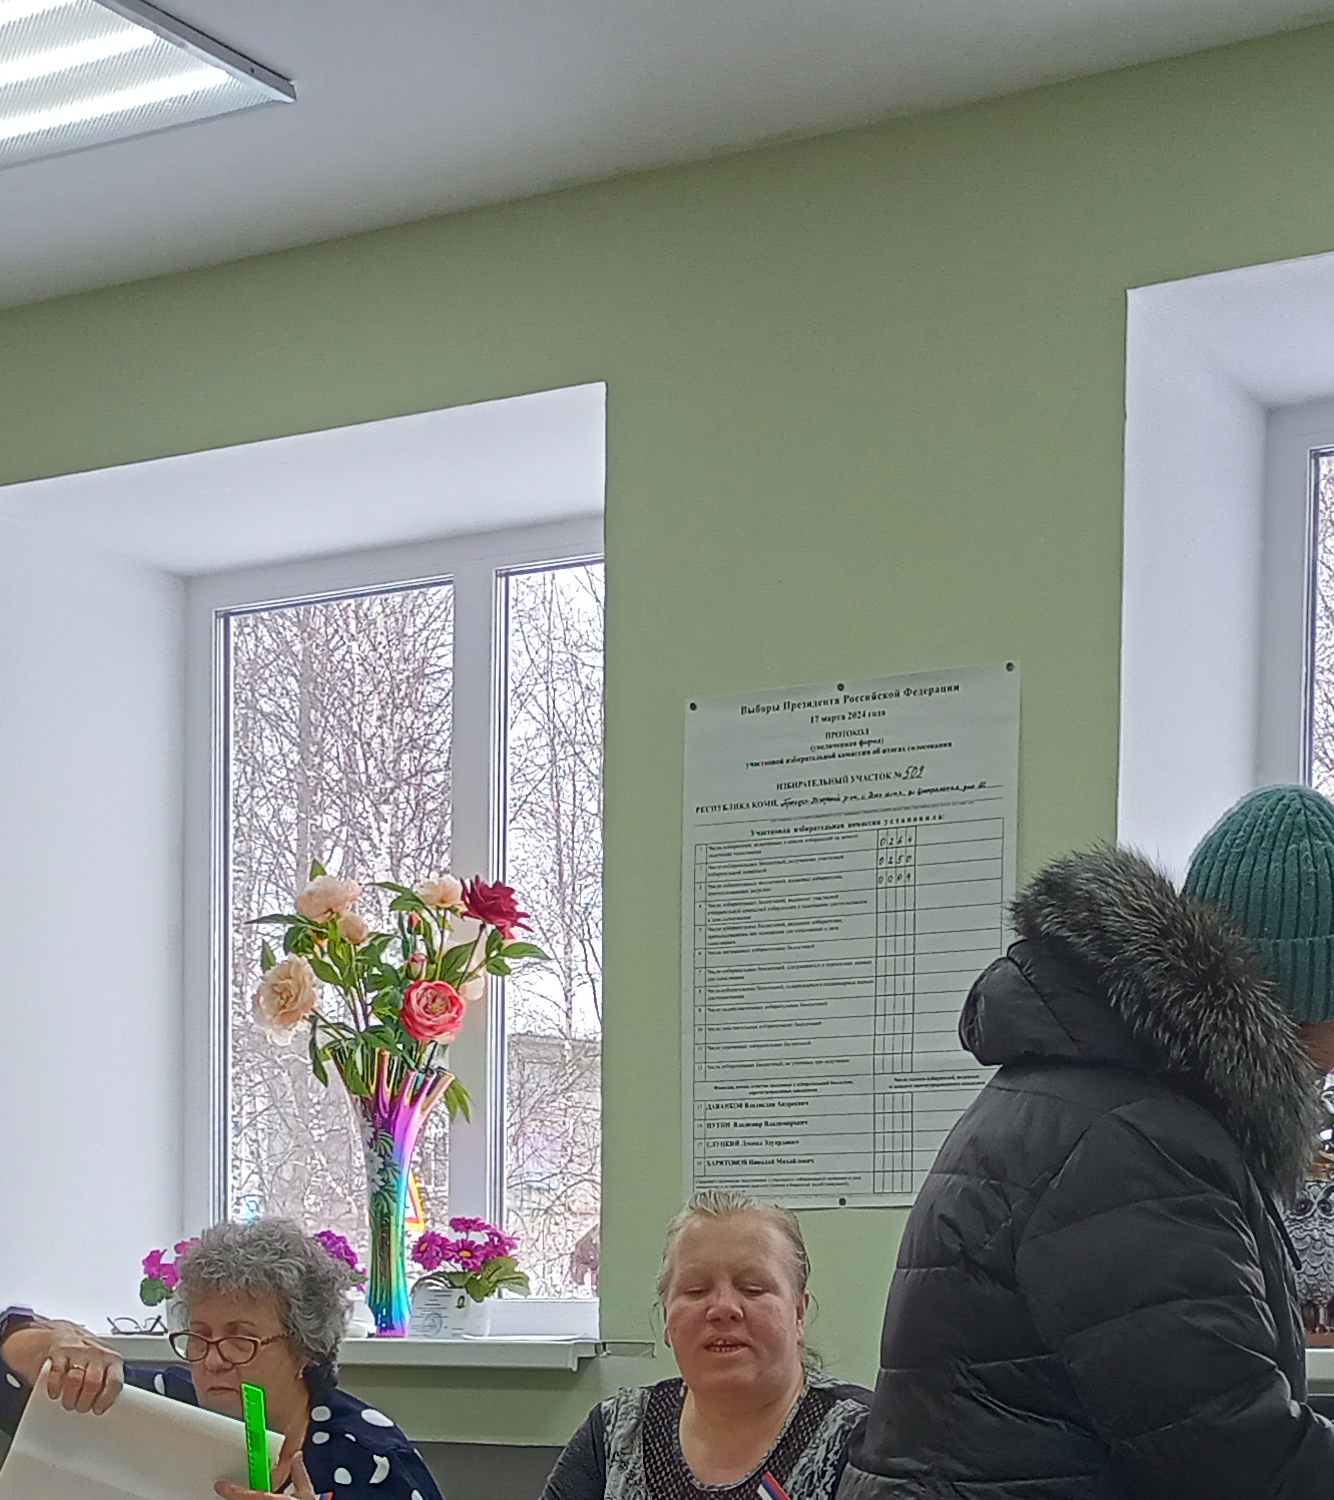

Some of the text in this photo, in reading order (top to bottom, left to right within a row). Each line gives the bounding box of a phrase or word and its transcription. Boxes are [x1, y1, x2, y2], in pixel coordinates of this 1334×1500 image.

[740, 683, 961, 717] Выборы Президента Российской Федерации
[810, 714, 819, 725] 17
[821, 713, 846, 724] марта
[847, 710, 867, 721] 2024
[825, 727, 870, 740] ПРОТОКОЛ
[776, 775, 849, 791] ИЗБИРАТЕЛЬНЫЙ
[850, 770, 891, 786] УЧАСТОК
[695, 800, 750, 814] РЕСПУБЛИКА
